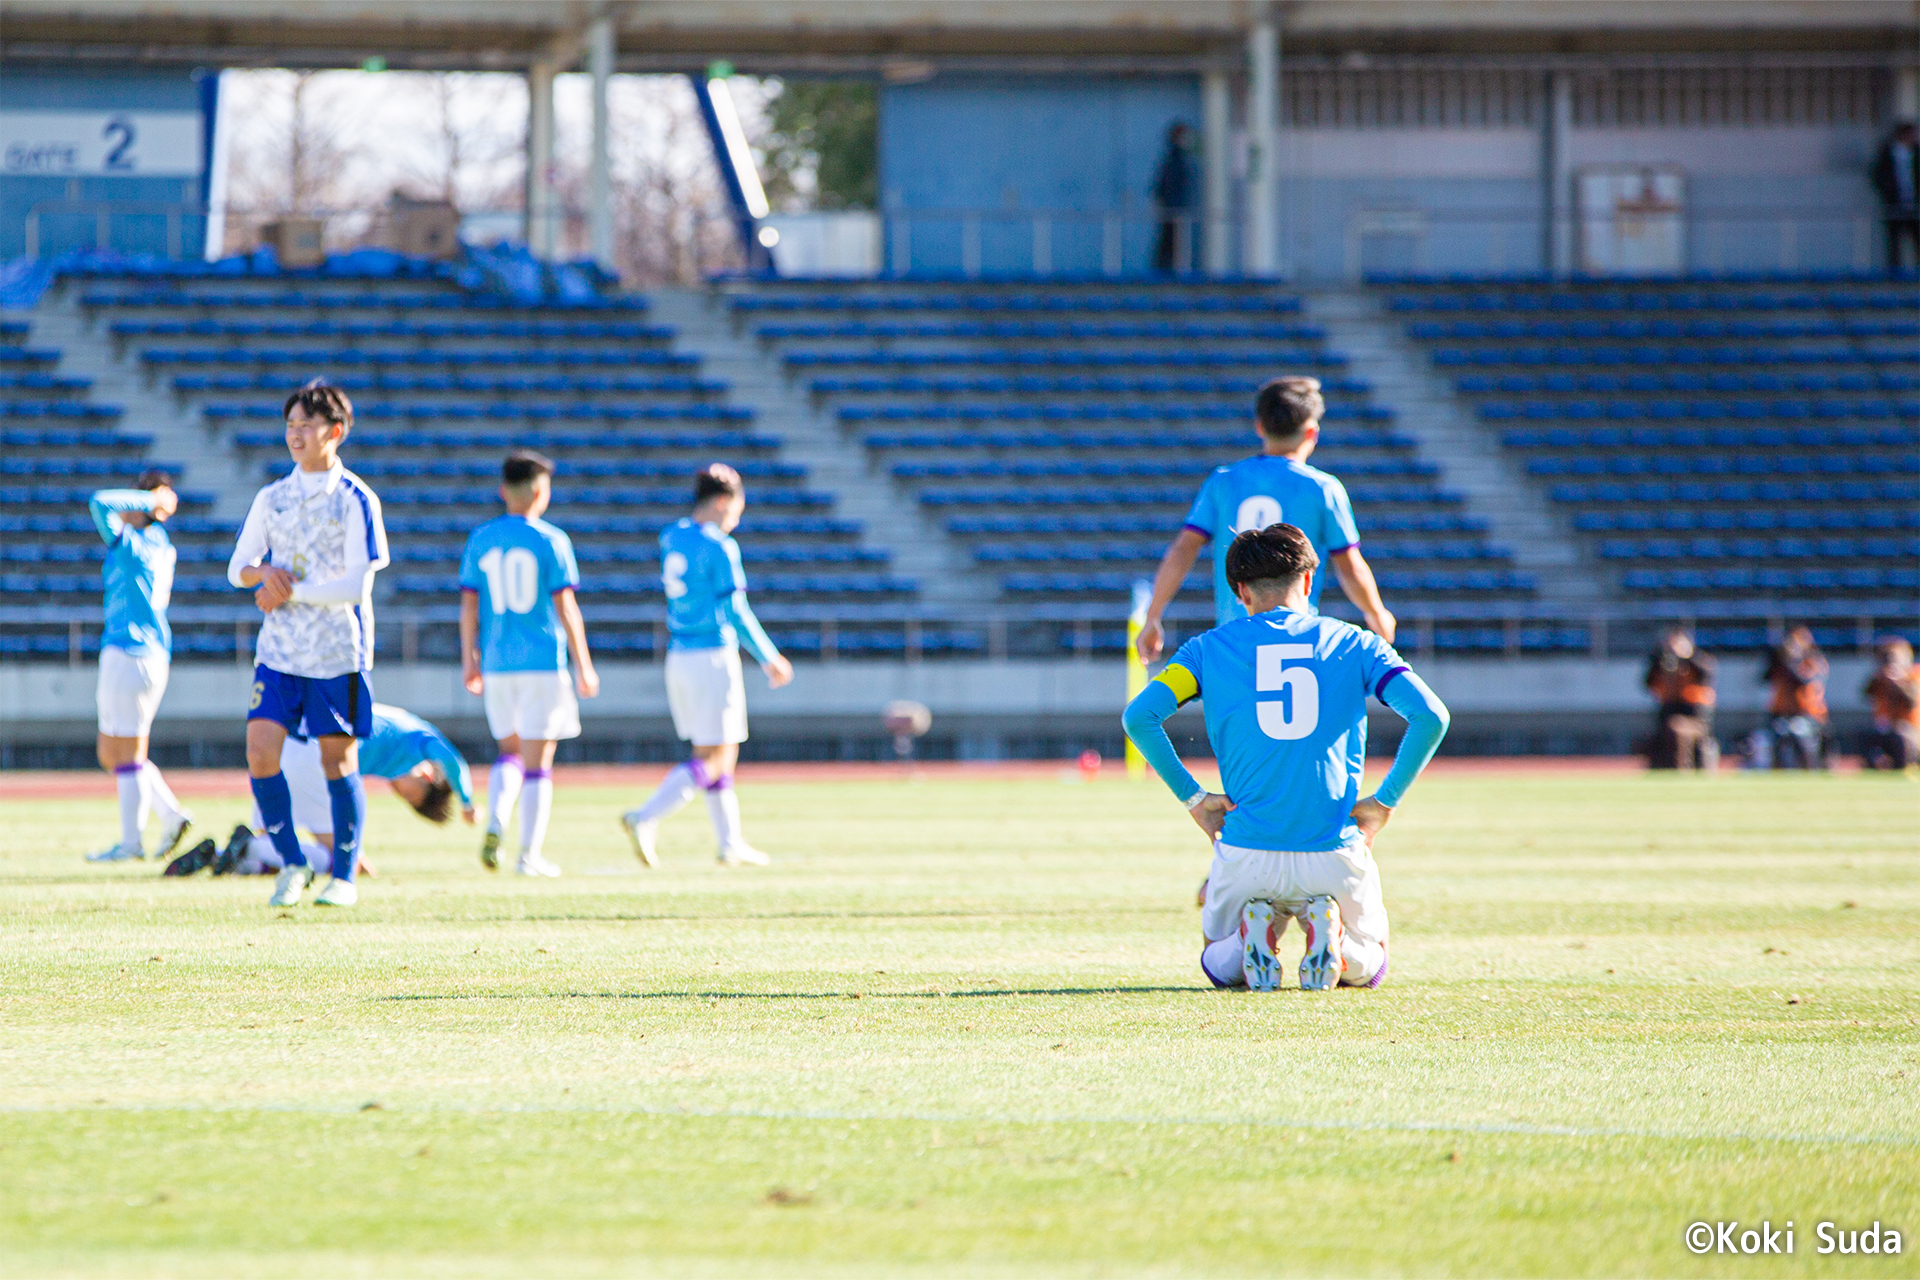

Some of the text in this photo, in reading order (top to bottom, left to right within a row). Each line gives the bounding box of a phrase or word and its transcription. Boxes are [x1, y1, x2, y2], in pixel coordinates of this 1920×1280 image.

[103, 114, 136, 172] 2
[293, 553, 306, 582] 6
[478, 546, 538, 614] 10
[249, 681, 265, 710] 6
[1256, 643, 1319, 740] 5
